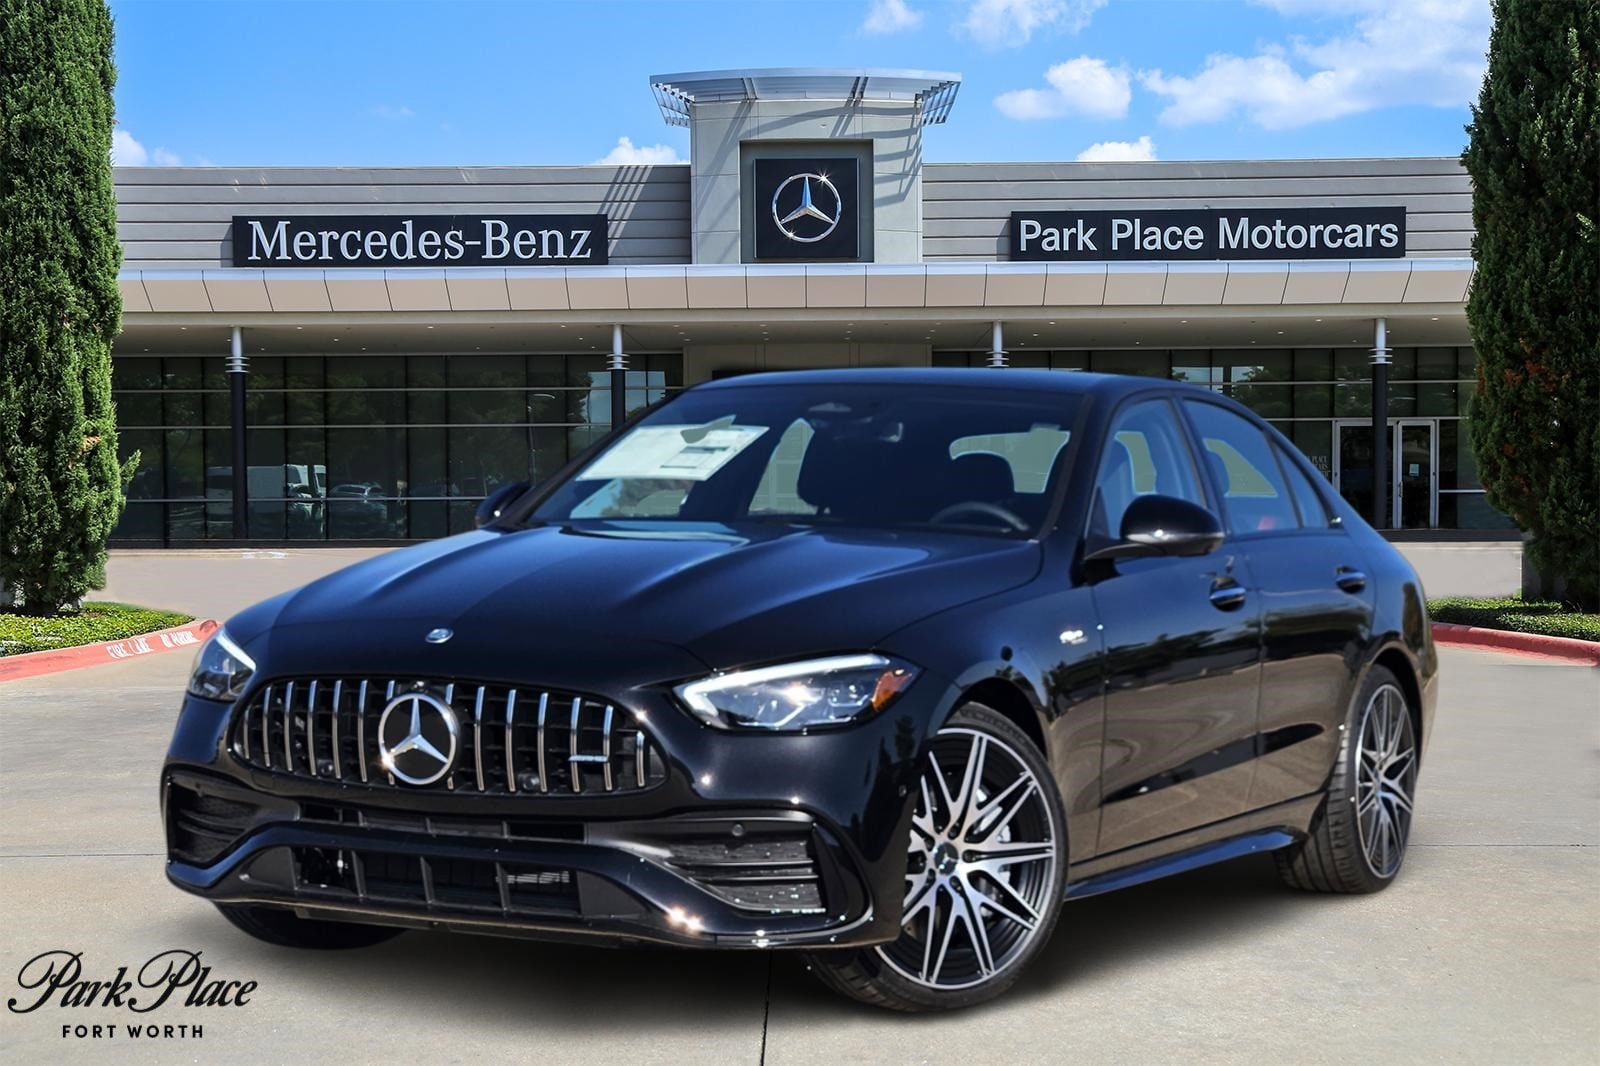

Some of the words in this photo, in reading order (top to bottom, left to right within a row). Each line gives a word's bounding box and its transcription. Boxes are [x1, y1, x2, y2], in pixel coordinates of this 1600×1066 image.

[247, 219, 592, 261] Mercedes-Benz
[1019, 218, 1098, 252] Park
[1111, 217, 1204, 251] Place
[1218, 216, 1400, 250] Motorcars
